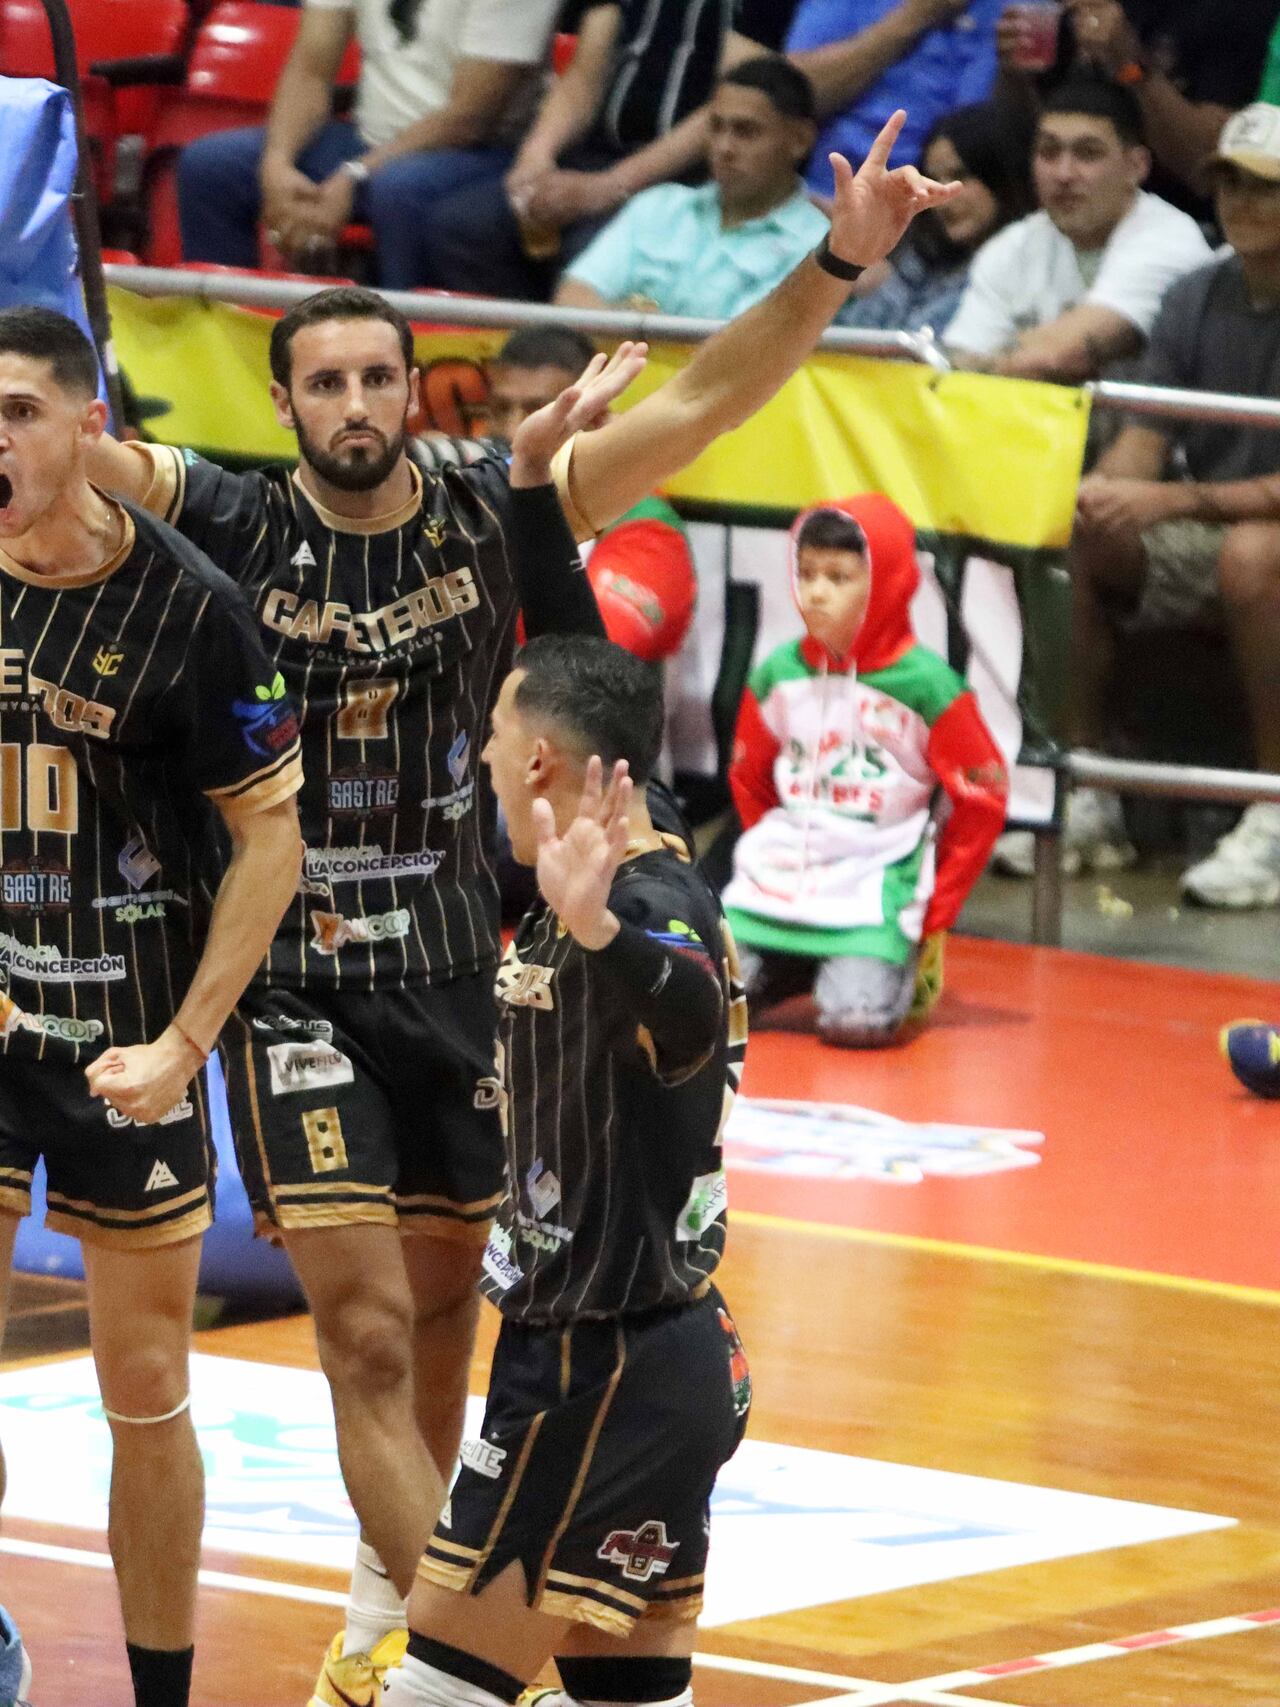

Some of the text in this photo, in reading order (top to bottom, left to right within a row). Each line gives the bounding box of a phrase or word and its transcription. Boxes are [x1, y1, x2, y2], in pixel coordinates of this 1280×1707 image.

[263, 567, 480, 653] CAFETEROS
[331, 779, 397, 809] SASTRE
[332, 849, 443, 872] CONCEPCIÓN
[4, 873, 69, 903] SASTRE
[16, 954, 124, 974] CONCEPCIÓN
[302, 1106, 349, 1174] 8
